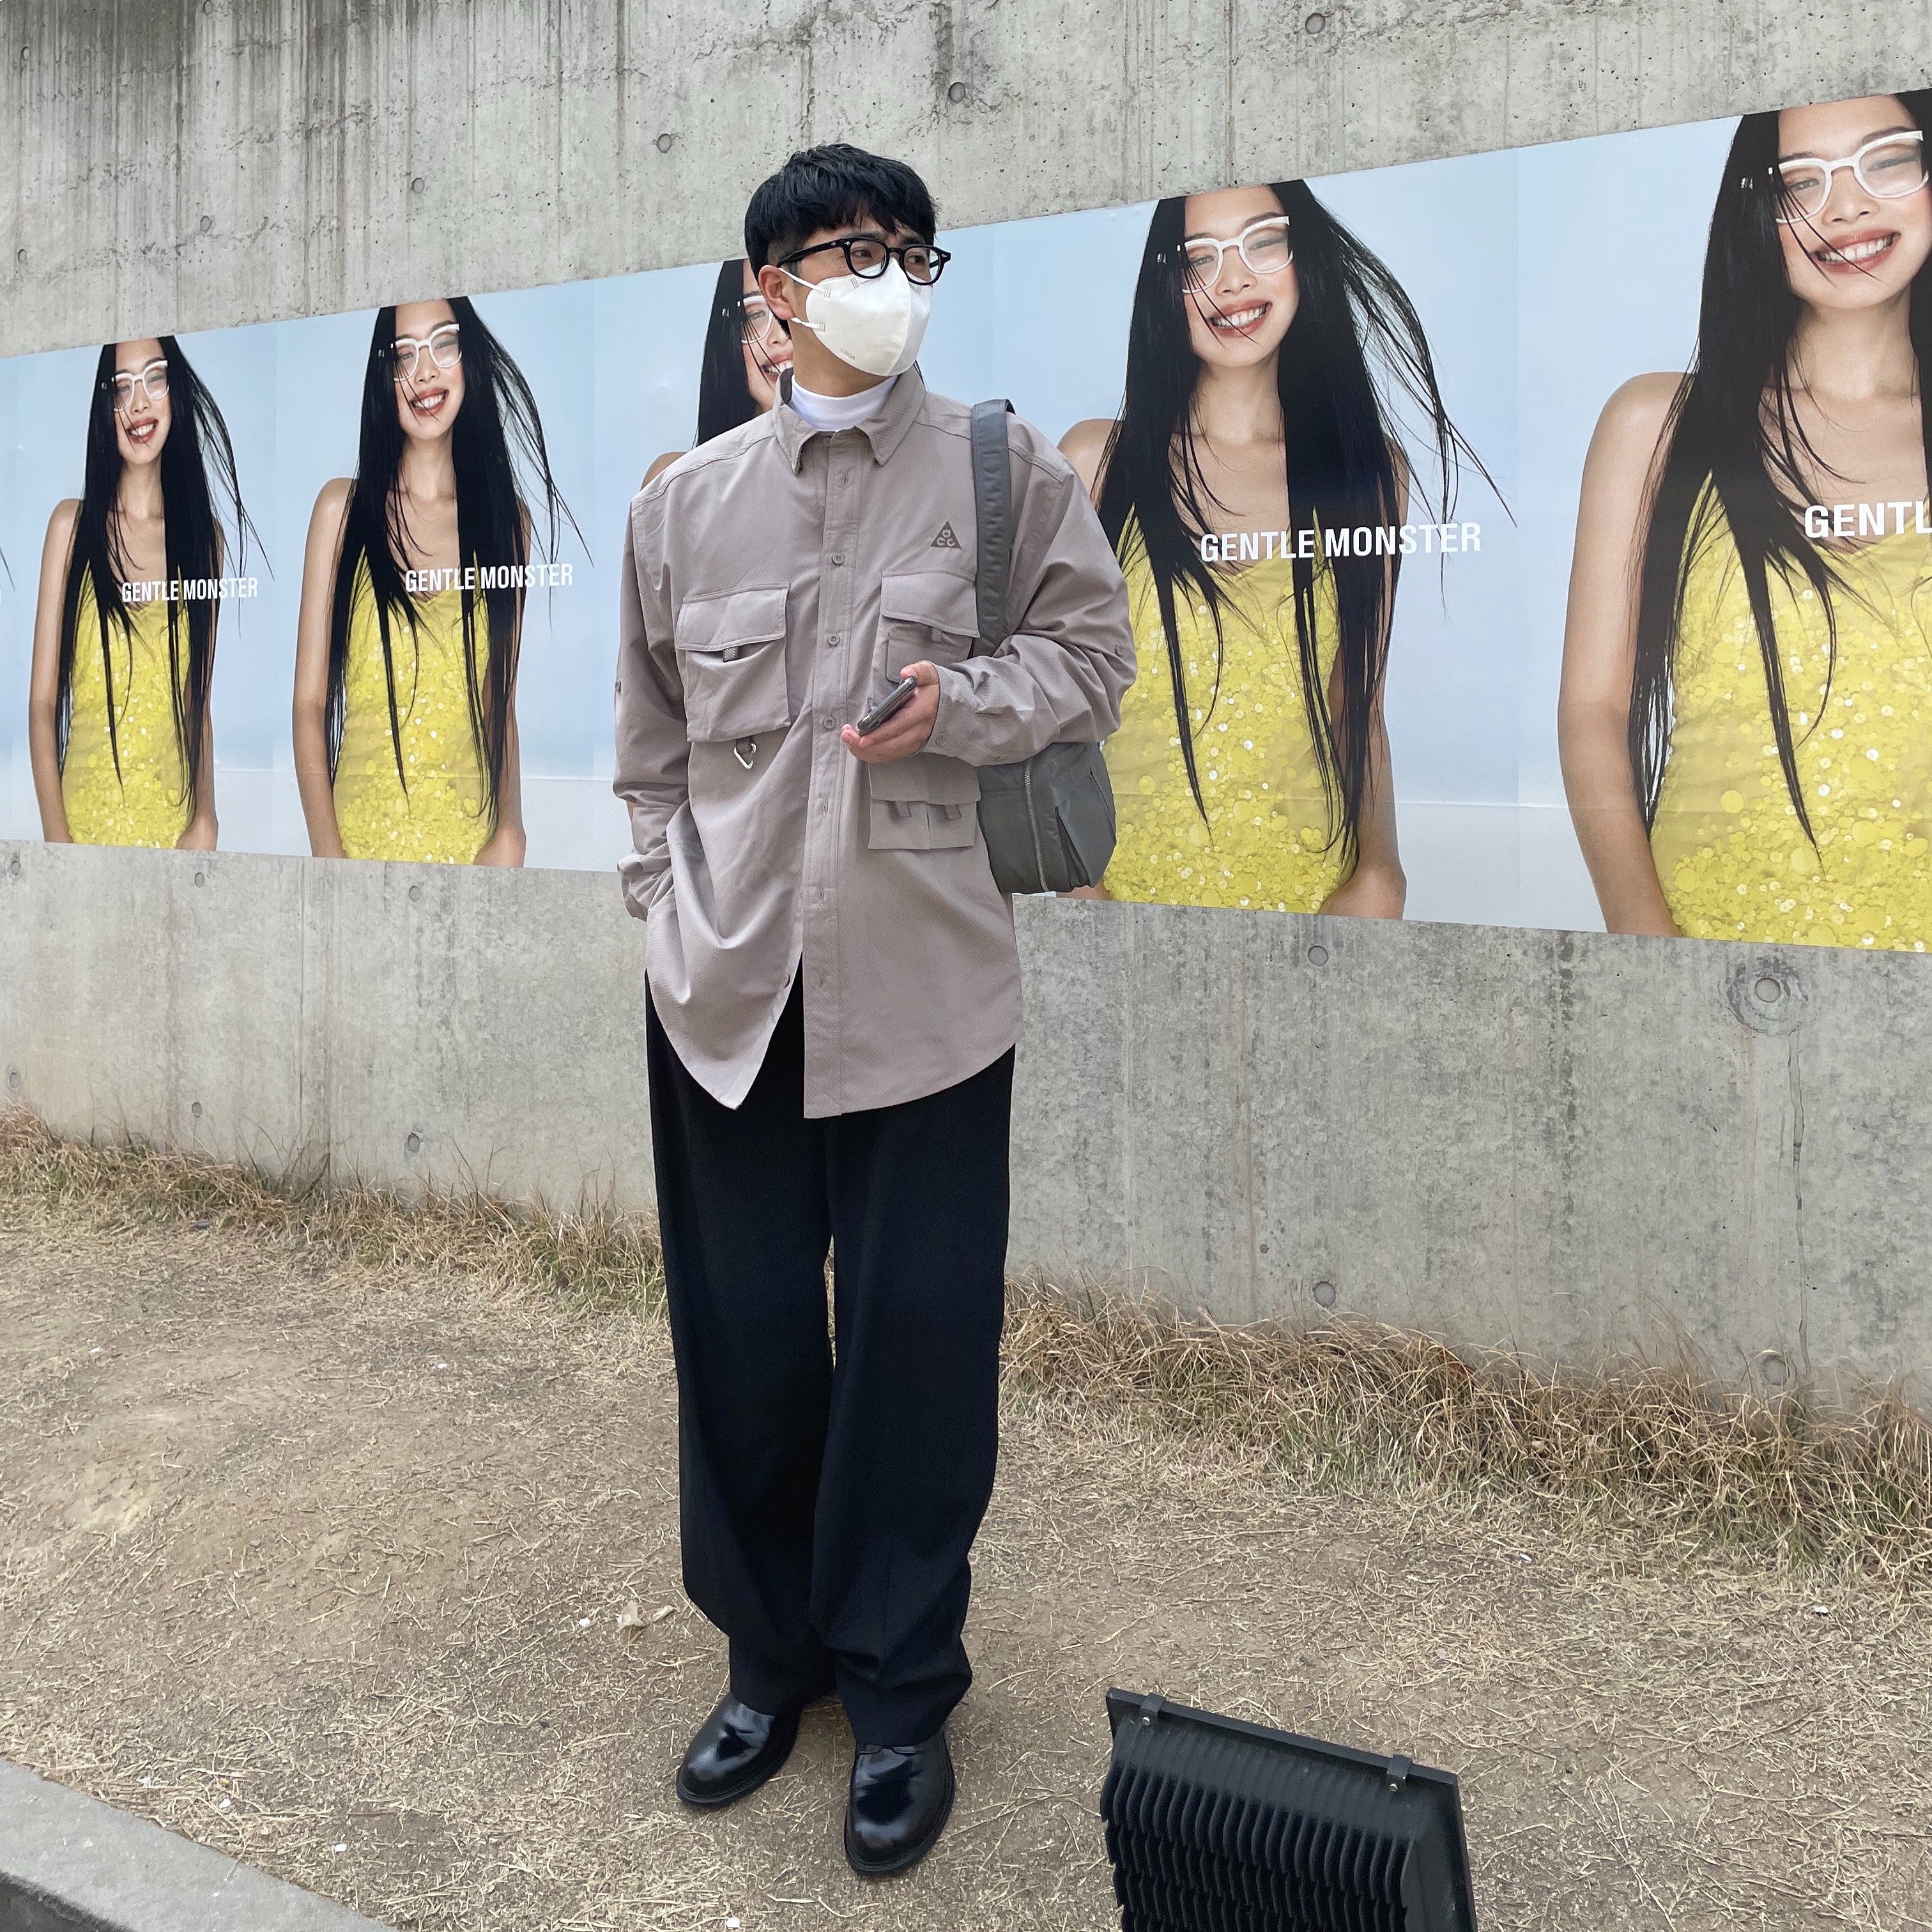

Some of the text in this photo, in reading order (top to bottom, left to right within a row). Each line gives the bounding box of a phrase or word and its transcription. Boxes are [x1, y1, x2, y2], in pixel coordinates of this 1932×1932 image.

[1200, 522, 1482, 562] GENTLE MONSTER
[121, 577, 258, 602] GENTLE MONSTER
[405, 563, 574, 592] GENTLE MONSTER
